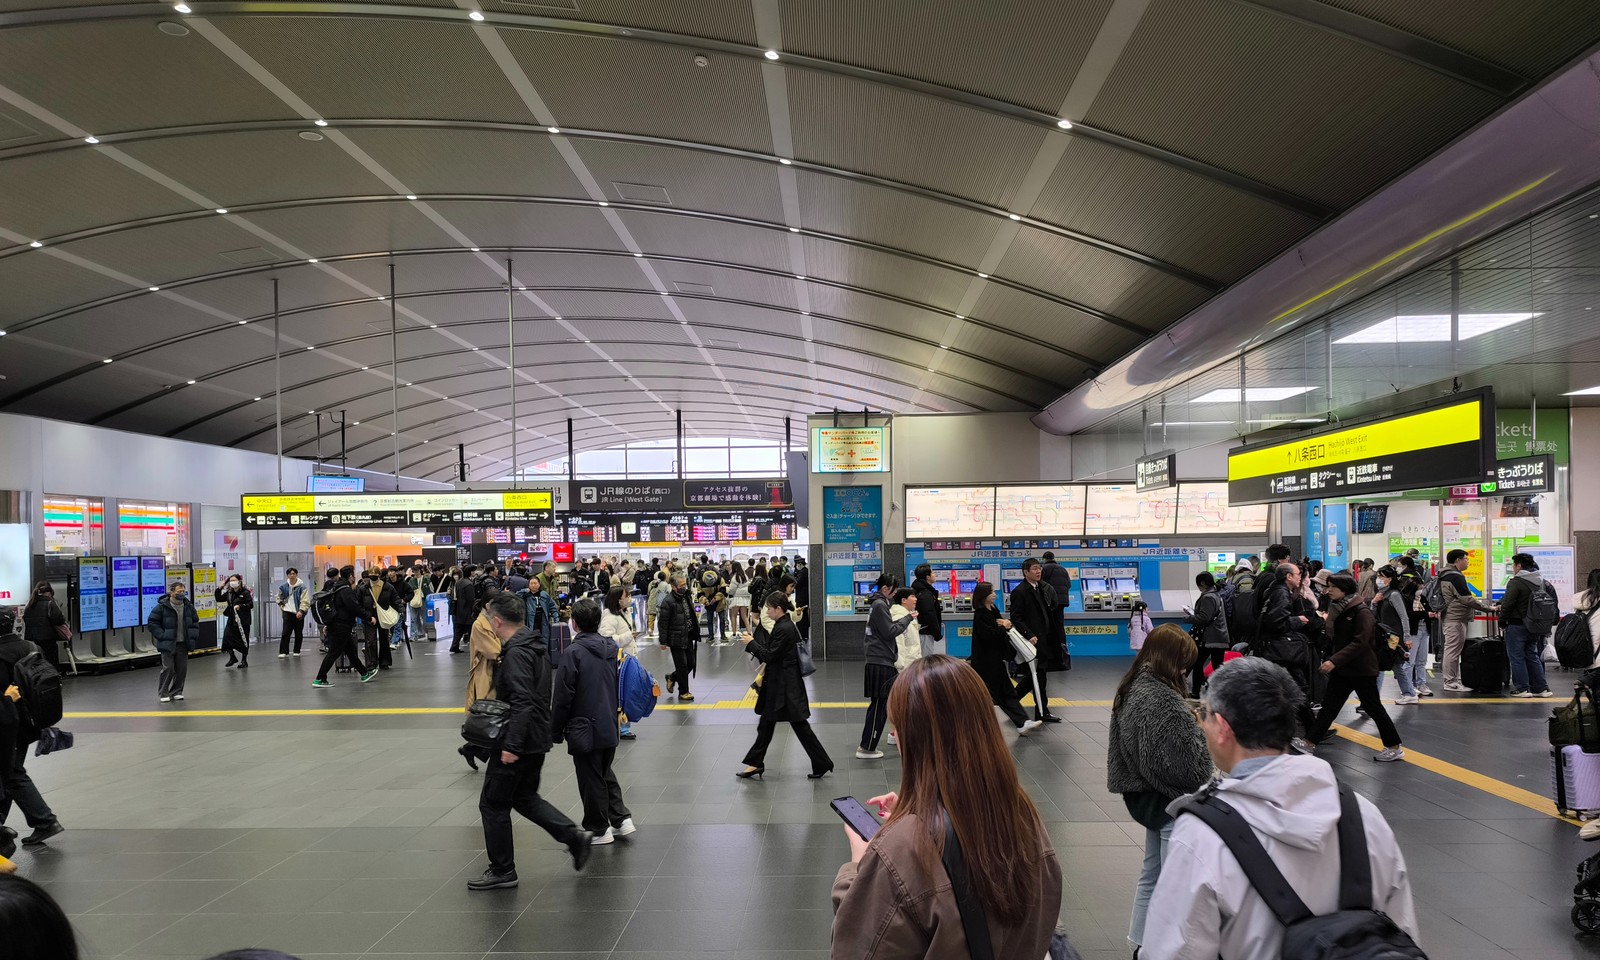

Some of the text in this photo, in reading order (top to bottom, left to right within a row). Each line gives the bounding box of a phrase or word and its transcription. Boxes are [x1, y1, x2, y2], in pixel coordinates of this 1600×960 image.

[1294, 444, 1325, 463] 八条西口
[1357, 463, 1378, 475] 近鉄電車
[1498, 462, 1543, 478] きっぷうりば
[1284, 475, 1296, 485] 新幹線
[1319, 470, 1336, 480] タクシー
[1373, 473, 1381, 482] Line
[1498, 480, 1515, 489] Tickets
[971, 549, 1032, 558] JR近距離きっぷ
